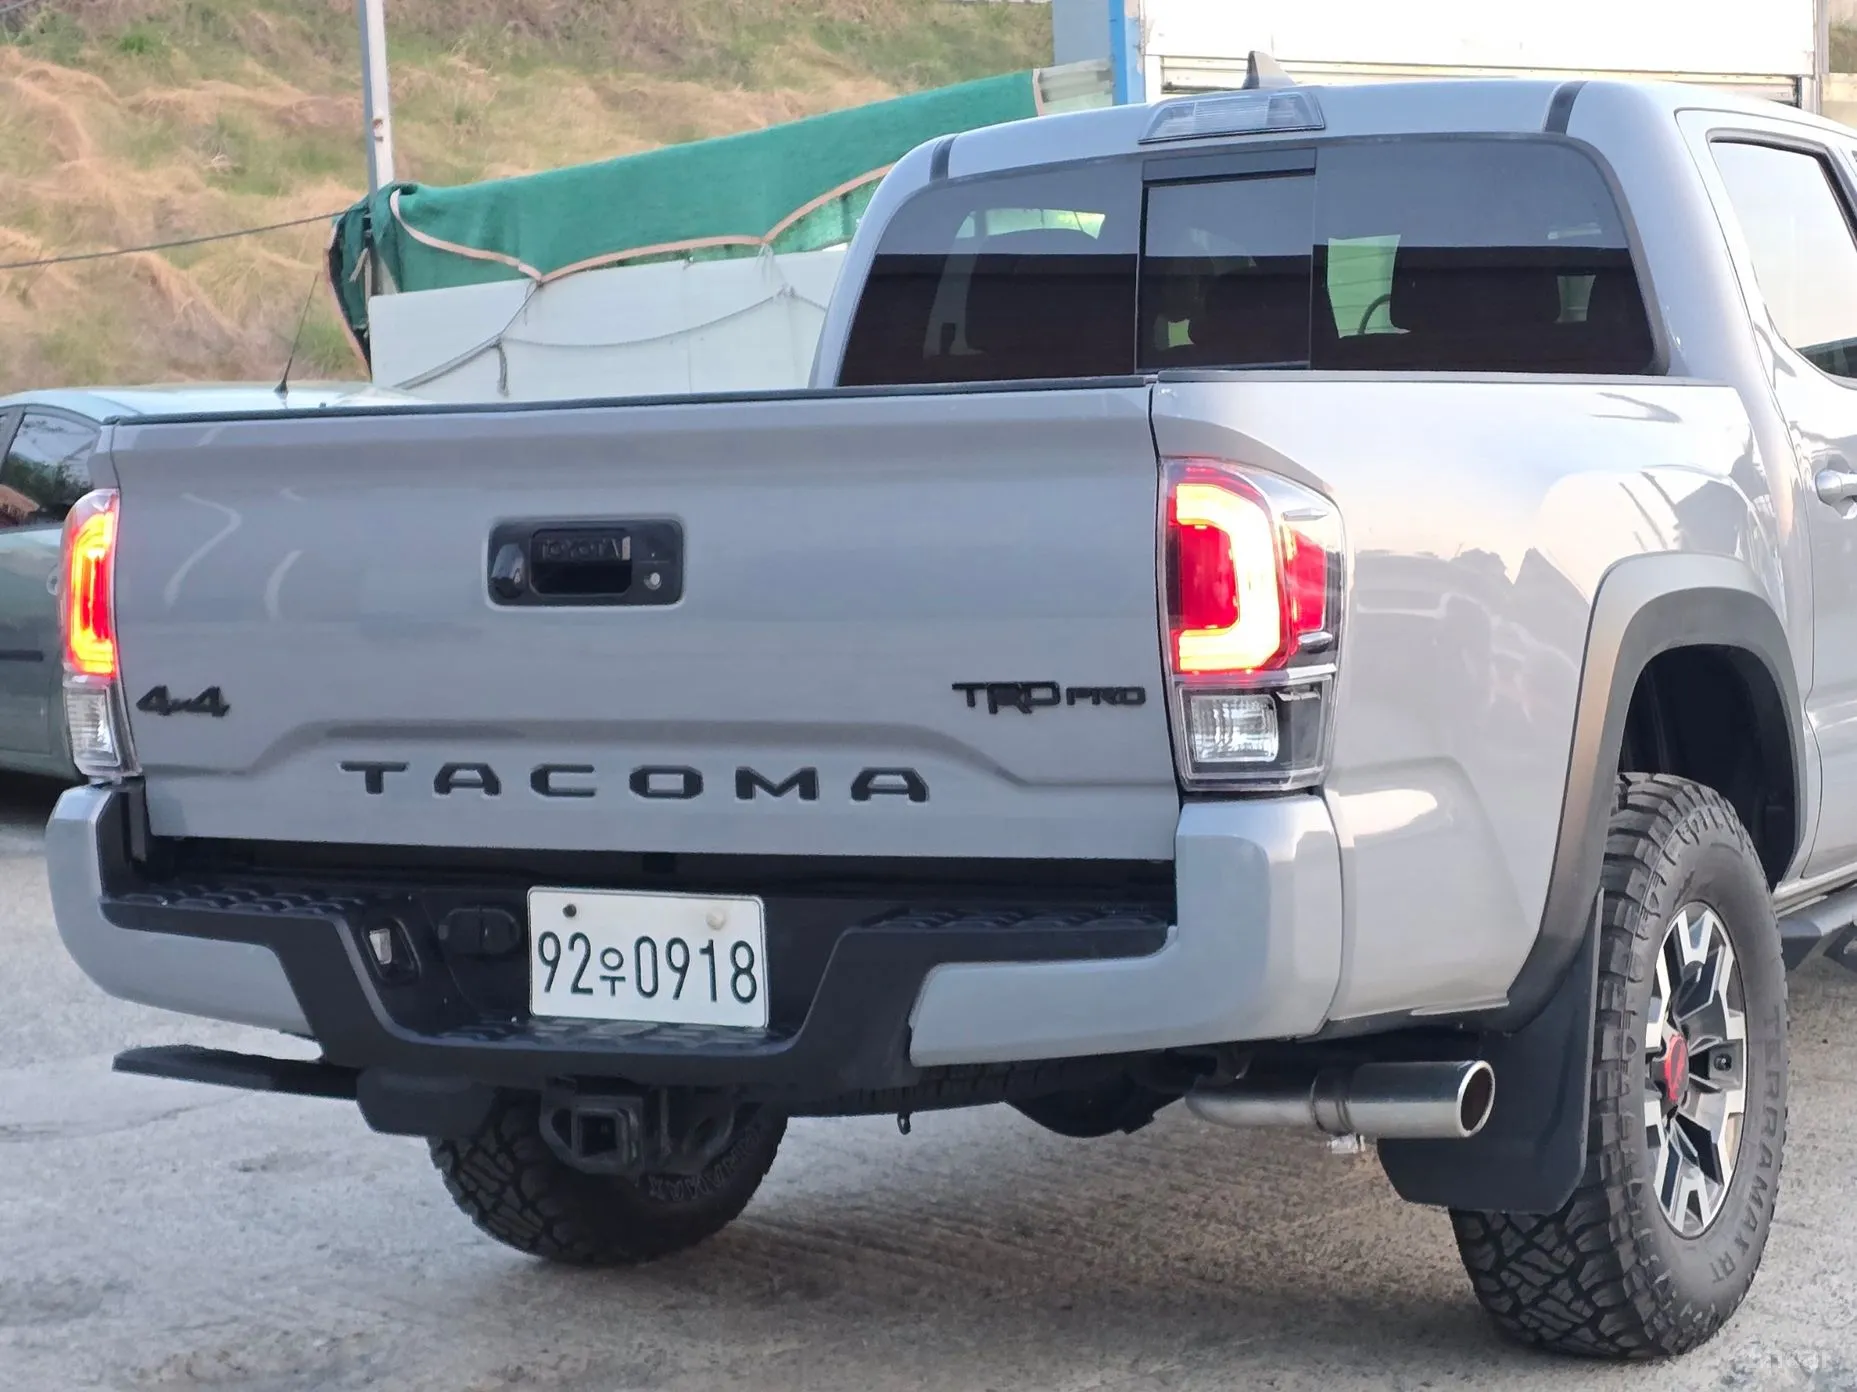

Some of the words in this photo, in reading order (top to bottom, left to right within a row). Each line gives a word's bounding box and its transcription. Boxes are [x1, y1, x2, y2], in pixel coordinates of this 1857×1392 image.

[952, 681, 1060, 714] TRD
[1066, 686, 1146, 706] PRO
[338, 760, 931, 803] TACOMA
[537, 931, 758, 1004] 92우0918
[1734, 1003, 1781, 1256] TERRAMAX
